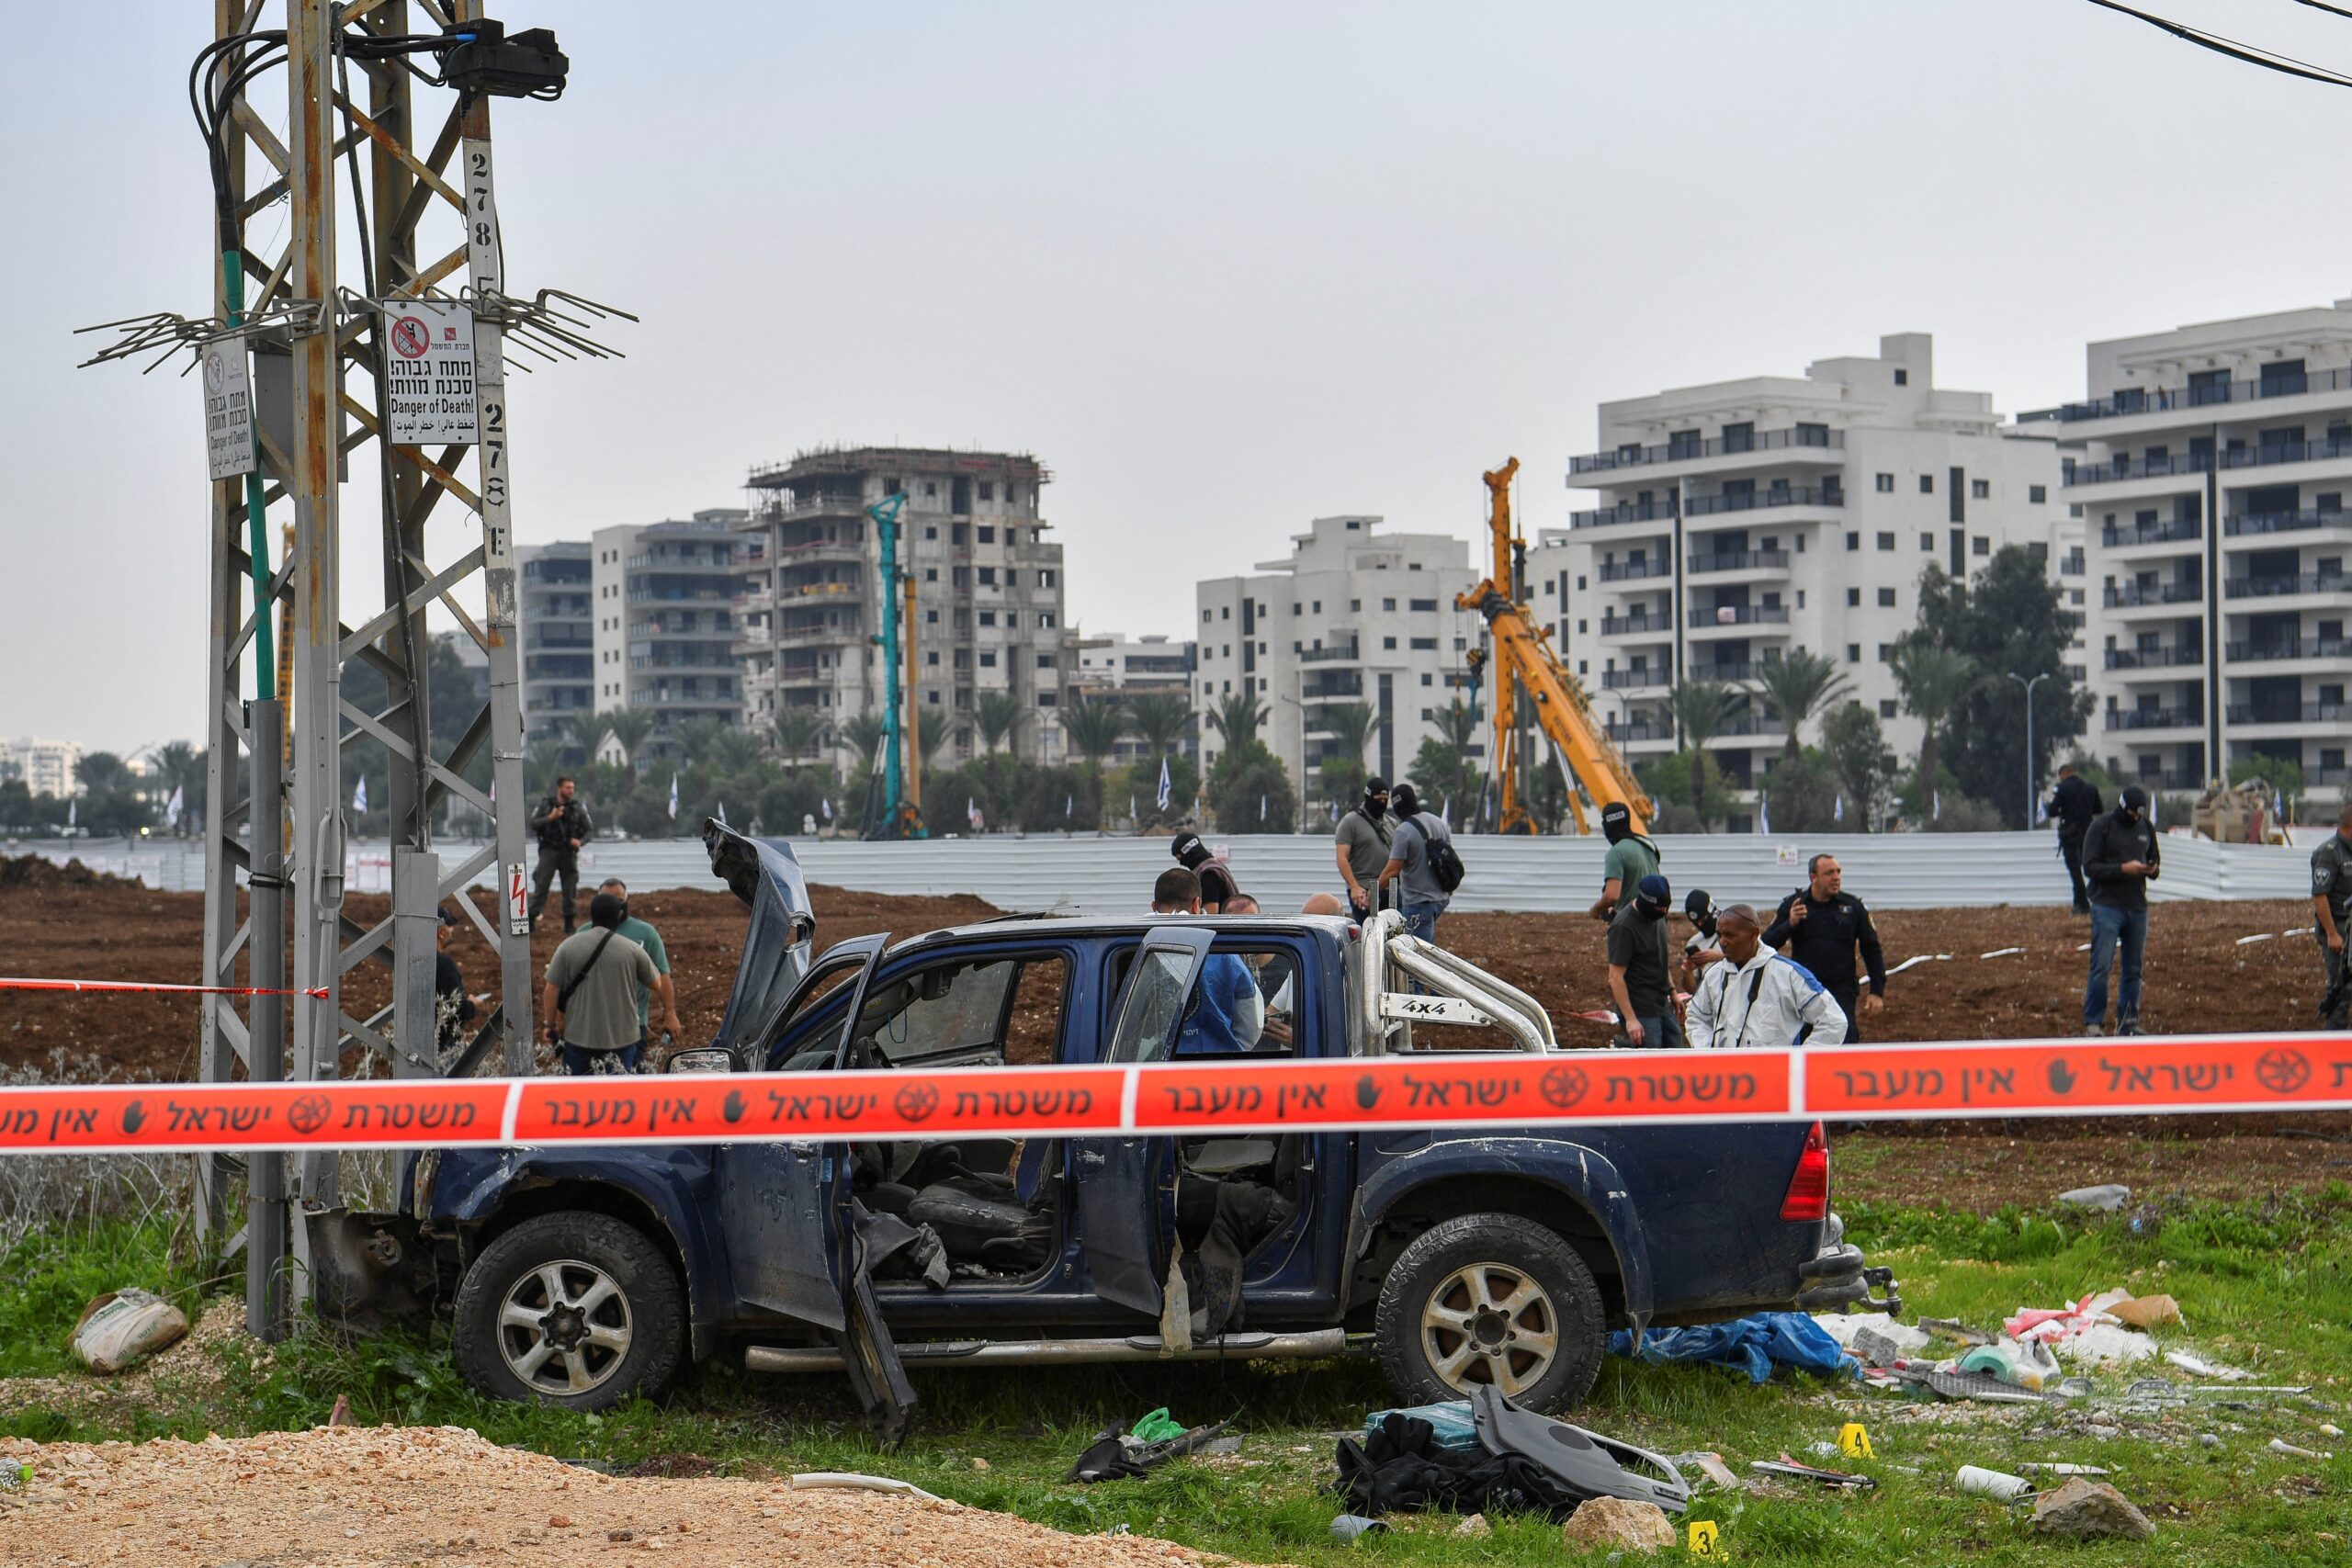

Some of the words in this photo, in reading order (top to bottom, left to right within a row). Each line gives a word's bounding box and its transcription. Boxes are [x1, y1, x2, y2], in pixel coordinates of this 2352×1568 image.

[471, 152, 492, 246] 278
[430, 343, 452, 351] החשמל
[455, 343, 469, 351] חברת
[390, 360, 432, 376] גבוה!
[439, 360, 471, 376] מתח
[230, 390, 246, 409] מתח
[390, 379, 429, 395] מוות!
[435, 379, 472, 395] סכנת
[209, 395, 227, 414] גבוה!
[229, 409, 247, 427] סכנת
[391, 398, 426, 417] Danger
[429, 398, 439, 413] of
[442, 398, 474, 413] Death!
[210, 435, 228, 451] Danger
[228, 431, 233, 444] of
[485, 404, 504, 506] 278
[1604, 1072, 1758, 1102] משטרת
[1834, 1068, 1945, 1100] מעבר
[1961, 1067, 2015, 1103] אין
[2099, 1056, 2234, 1091] ישראל
[767, 1088, 876, 1121] ישראל
[952, 1088, 1092, 1118] משטרת
[1163, 1085, 1262, 1115] מעבר
[1277, 1083, 1328, 1119] אין
[1402, 1074, 1521, 1107] ישראל
[49, 1107, 99, 1141] אין
[167, 1100, 271, 1132] ישראל
[343, 1101, 477, 1129] משטרת
[545, 1099, 636, 1128] מעבר
[649, 1098, 697, 1132] אין
[1855, 1431, 1864, 1451] 4
[1698, 1530, 1710, 1556] 3
